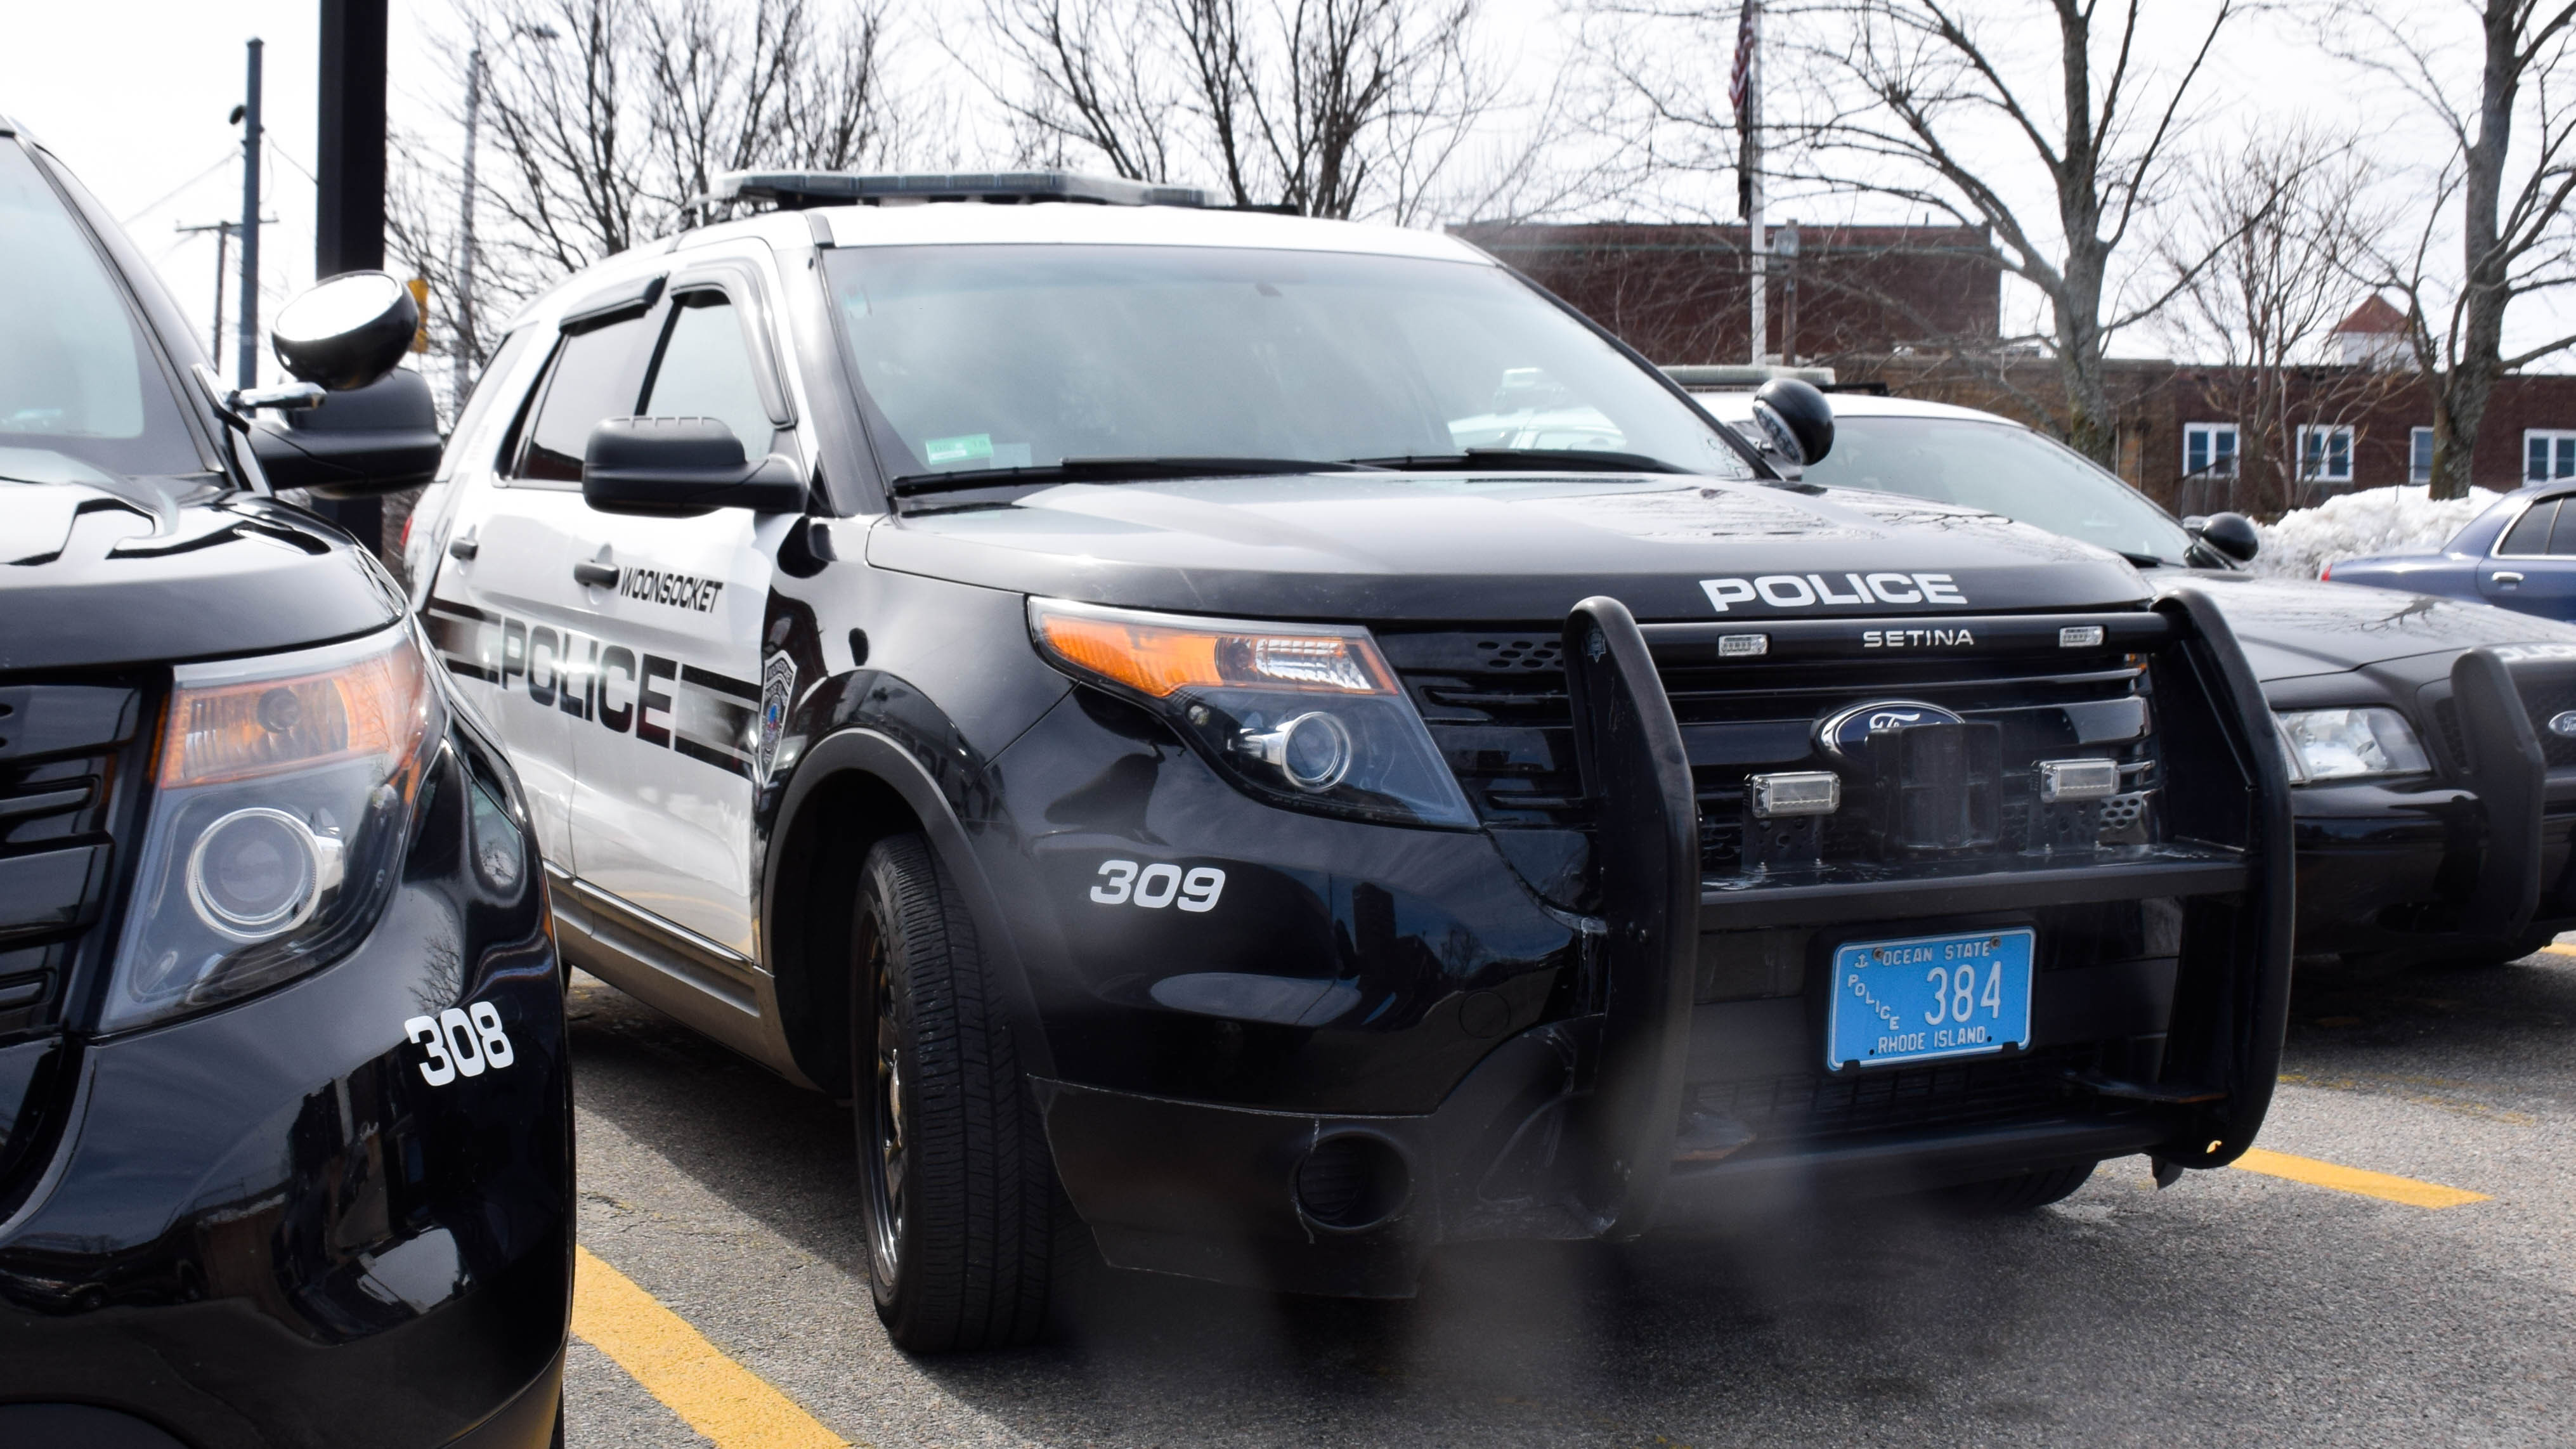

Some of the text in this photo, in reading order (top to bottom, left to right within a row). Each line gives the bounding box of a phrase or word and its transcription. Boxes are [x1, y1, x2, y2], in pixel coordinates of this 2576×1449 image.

[620, 566, 724, 613] WOONSOCKET
[1699, 573, 1968, 612] POLICE
[1863, 629, 1974, 647] SETINA
[502, 616, 677, 749] POLICE
[1090, 860, 1226, 912] 309
[1882, 941, 1990, 966] OCEAN STATE
[1847, 973, 1900, 1030] POLICE
[1924, 961, 2001, 1025] 384
[405, 1001, 514, 1086] 308
[1877, 1025, 1986, 1054] RHODE ISLAND
